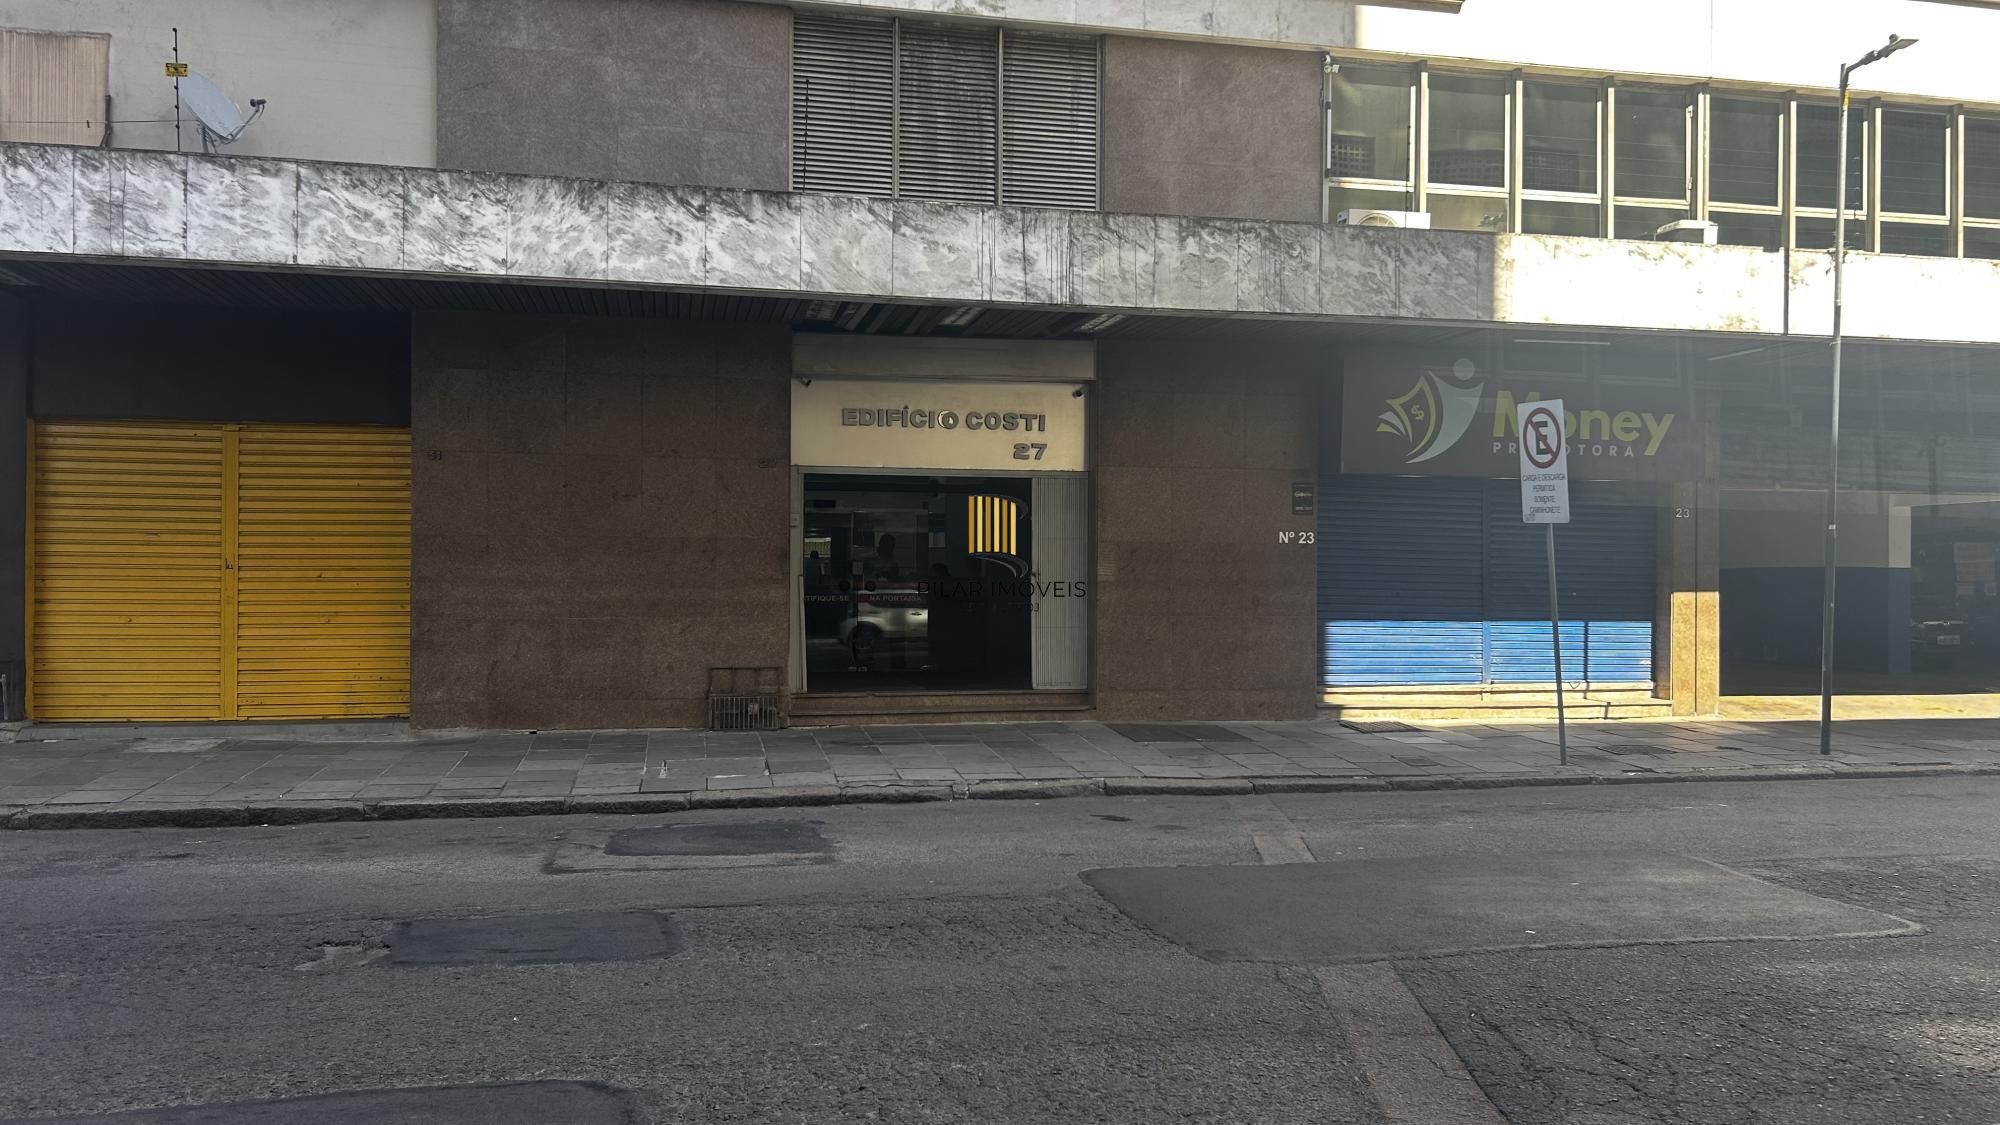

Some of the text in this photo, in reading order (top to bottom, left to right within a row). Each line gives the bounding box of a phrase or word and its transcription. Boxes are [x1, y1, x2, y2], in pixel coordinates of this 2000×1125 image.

[841, 405, 1046, 432] EDIFÍCIO COSTI
[1013, 443, 1048, 461] 27
[1493, 442, 1634, 457] PRTORA
[1675, 507, 1690, 518] 23
[1298, 531, 1315, 544] 23
